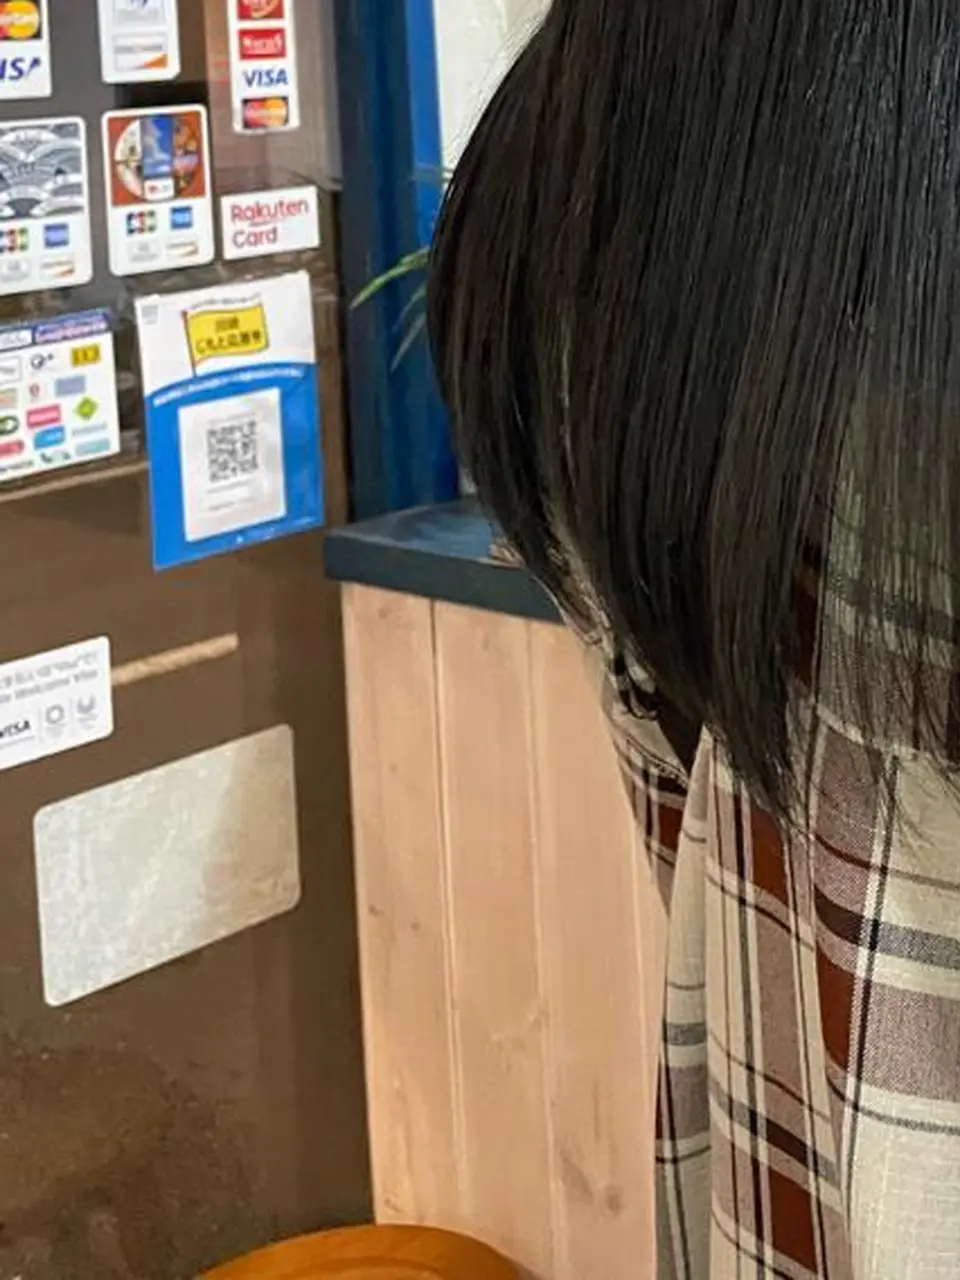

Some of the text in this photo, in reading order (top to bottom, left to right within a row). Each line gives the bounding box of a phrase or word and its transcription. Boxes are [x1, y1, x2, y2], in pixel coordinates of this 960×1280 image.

[243, 68, 288, 88] VISA
[231, 199, 309, 224] Rakuten
[232, 227, 278, 249] Card
